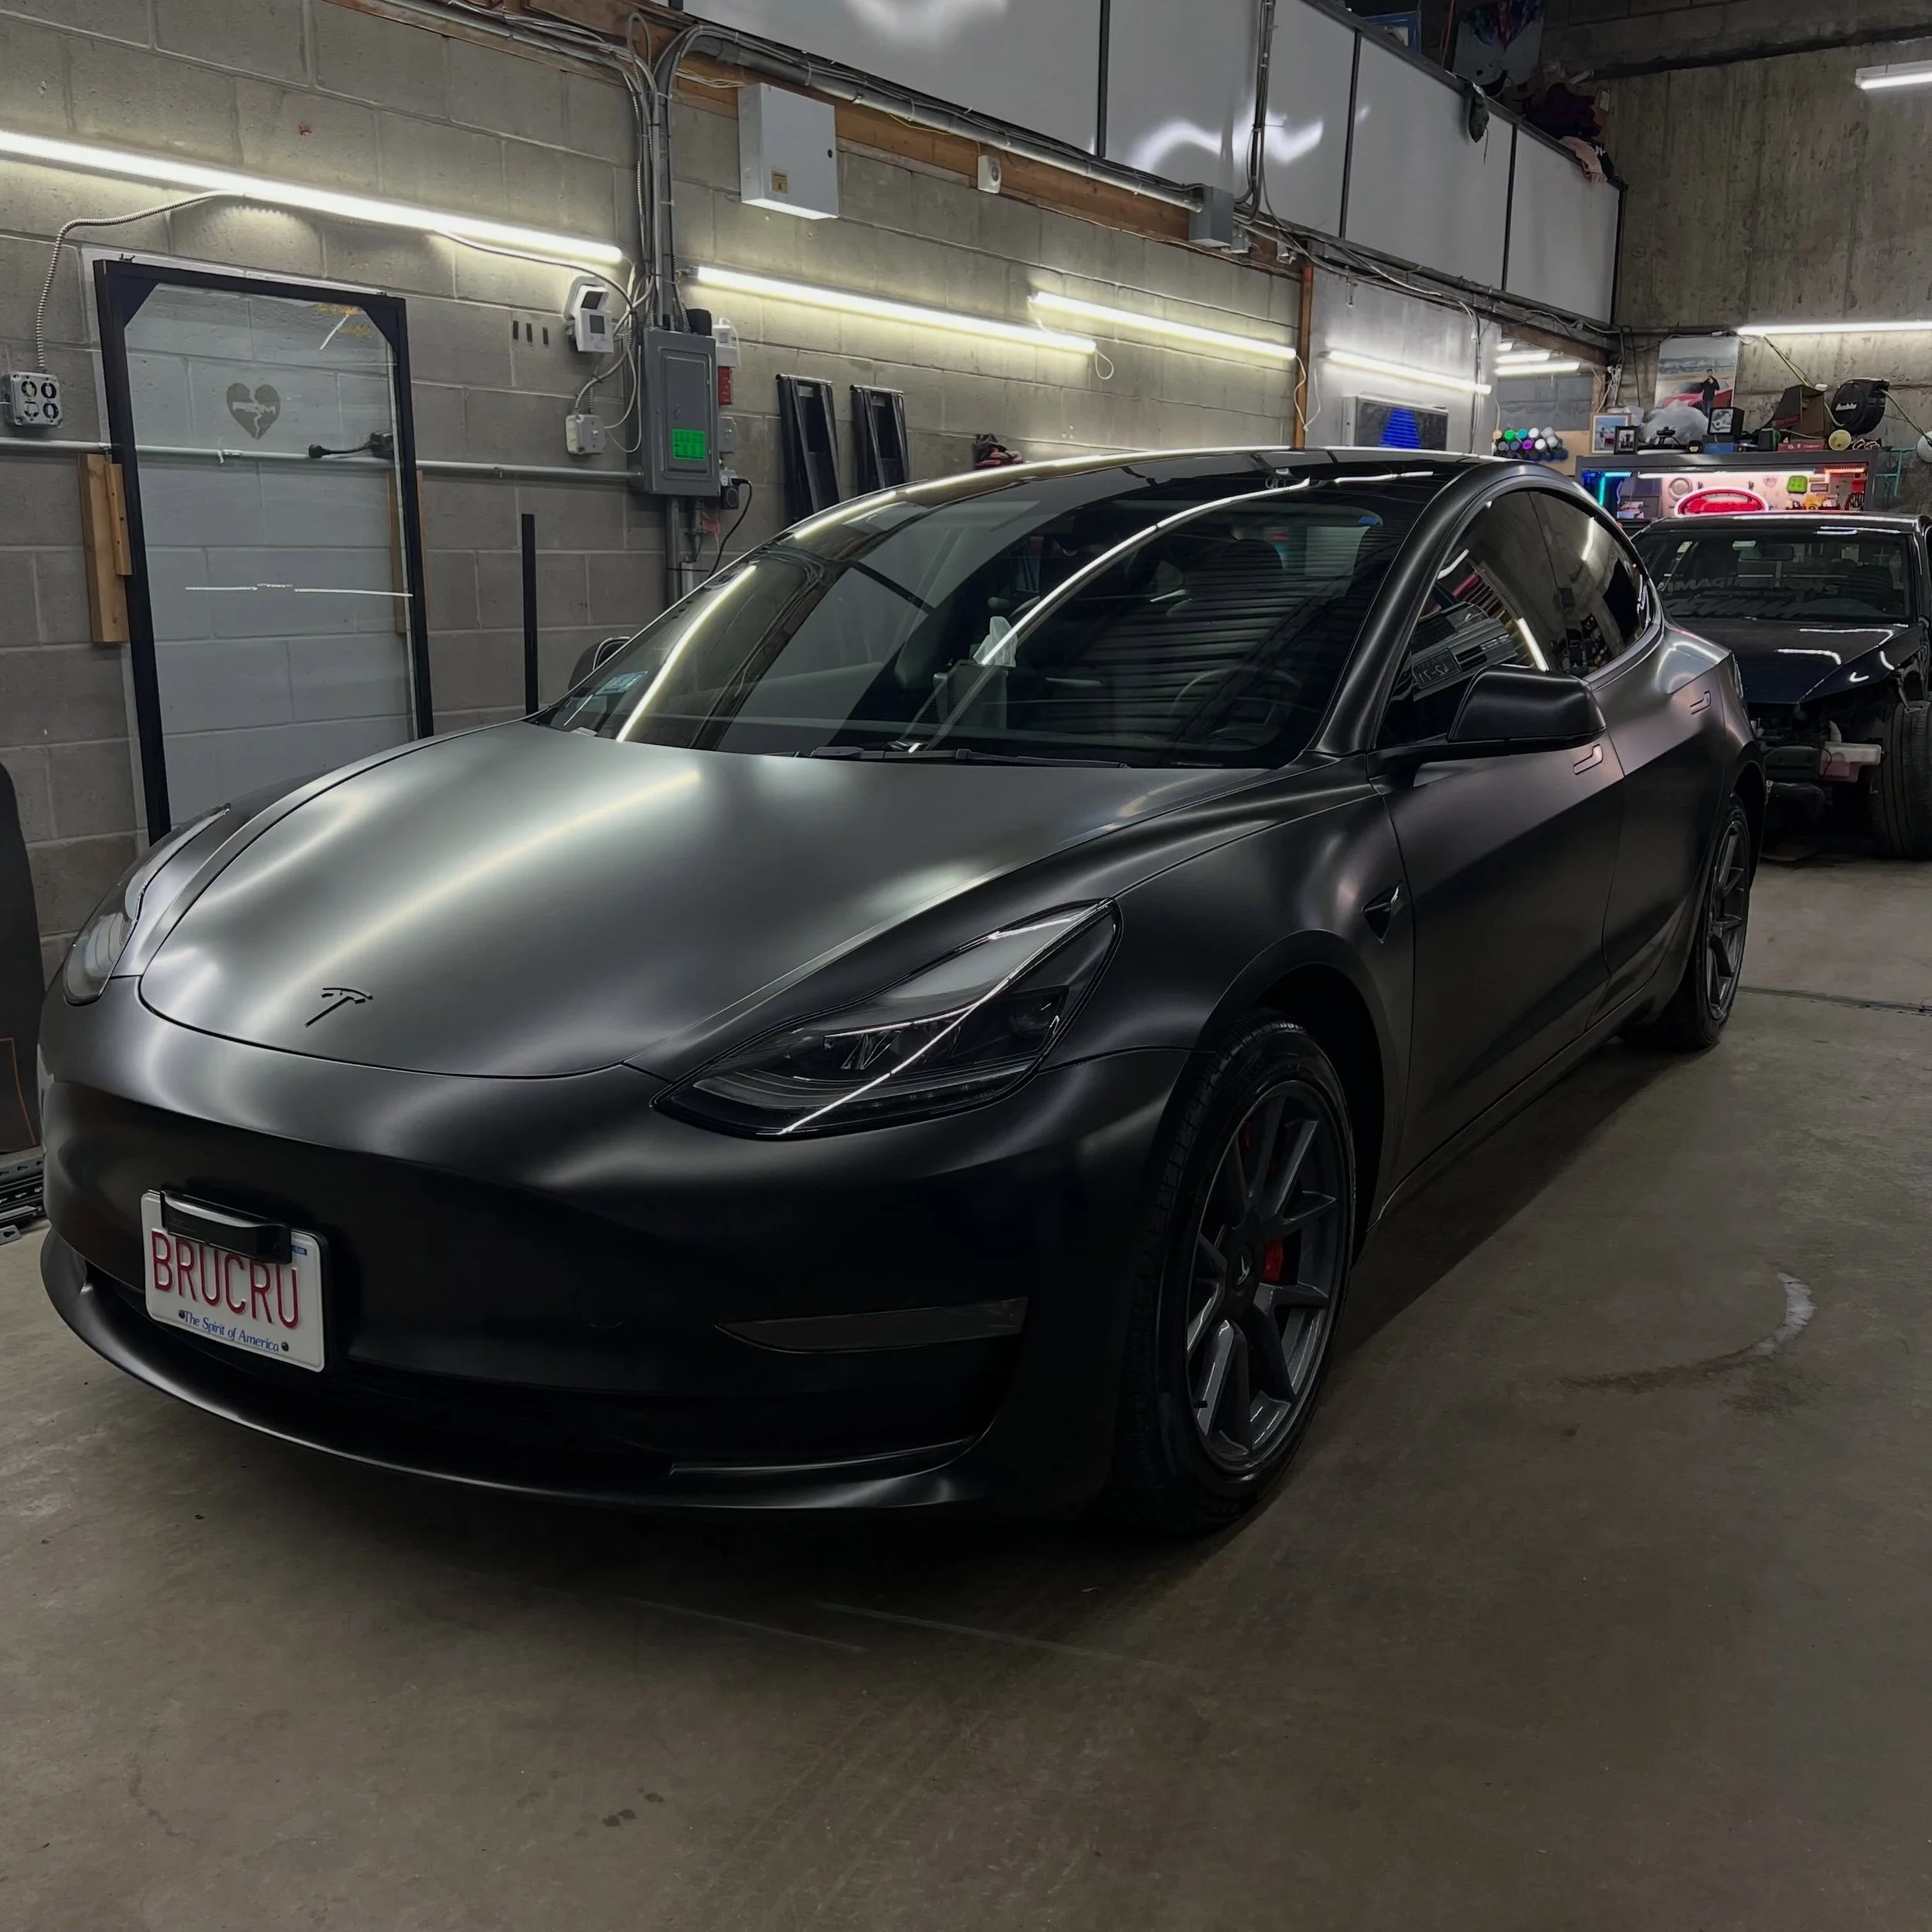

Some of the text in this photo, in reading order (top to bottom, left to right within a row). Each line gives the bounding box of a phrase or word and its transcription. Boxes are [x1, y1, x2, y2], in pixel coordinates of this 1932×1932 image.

[151, 1229, 298, 1329] BRUCRU
[185, 1311, 279, 1352] The Spirit of America
